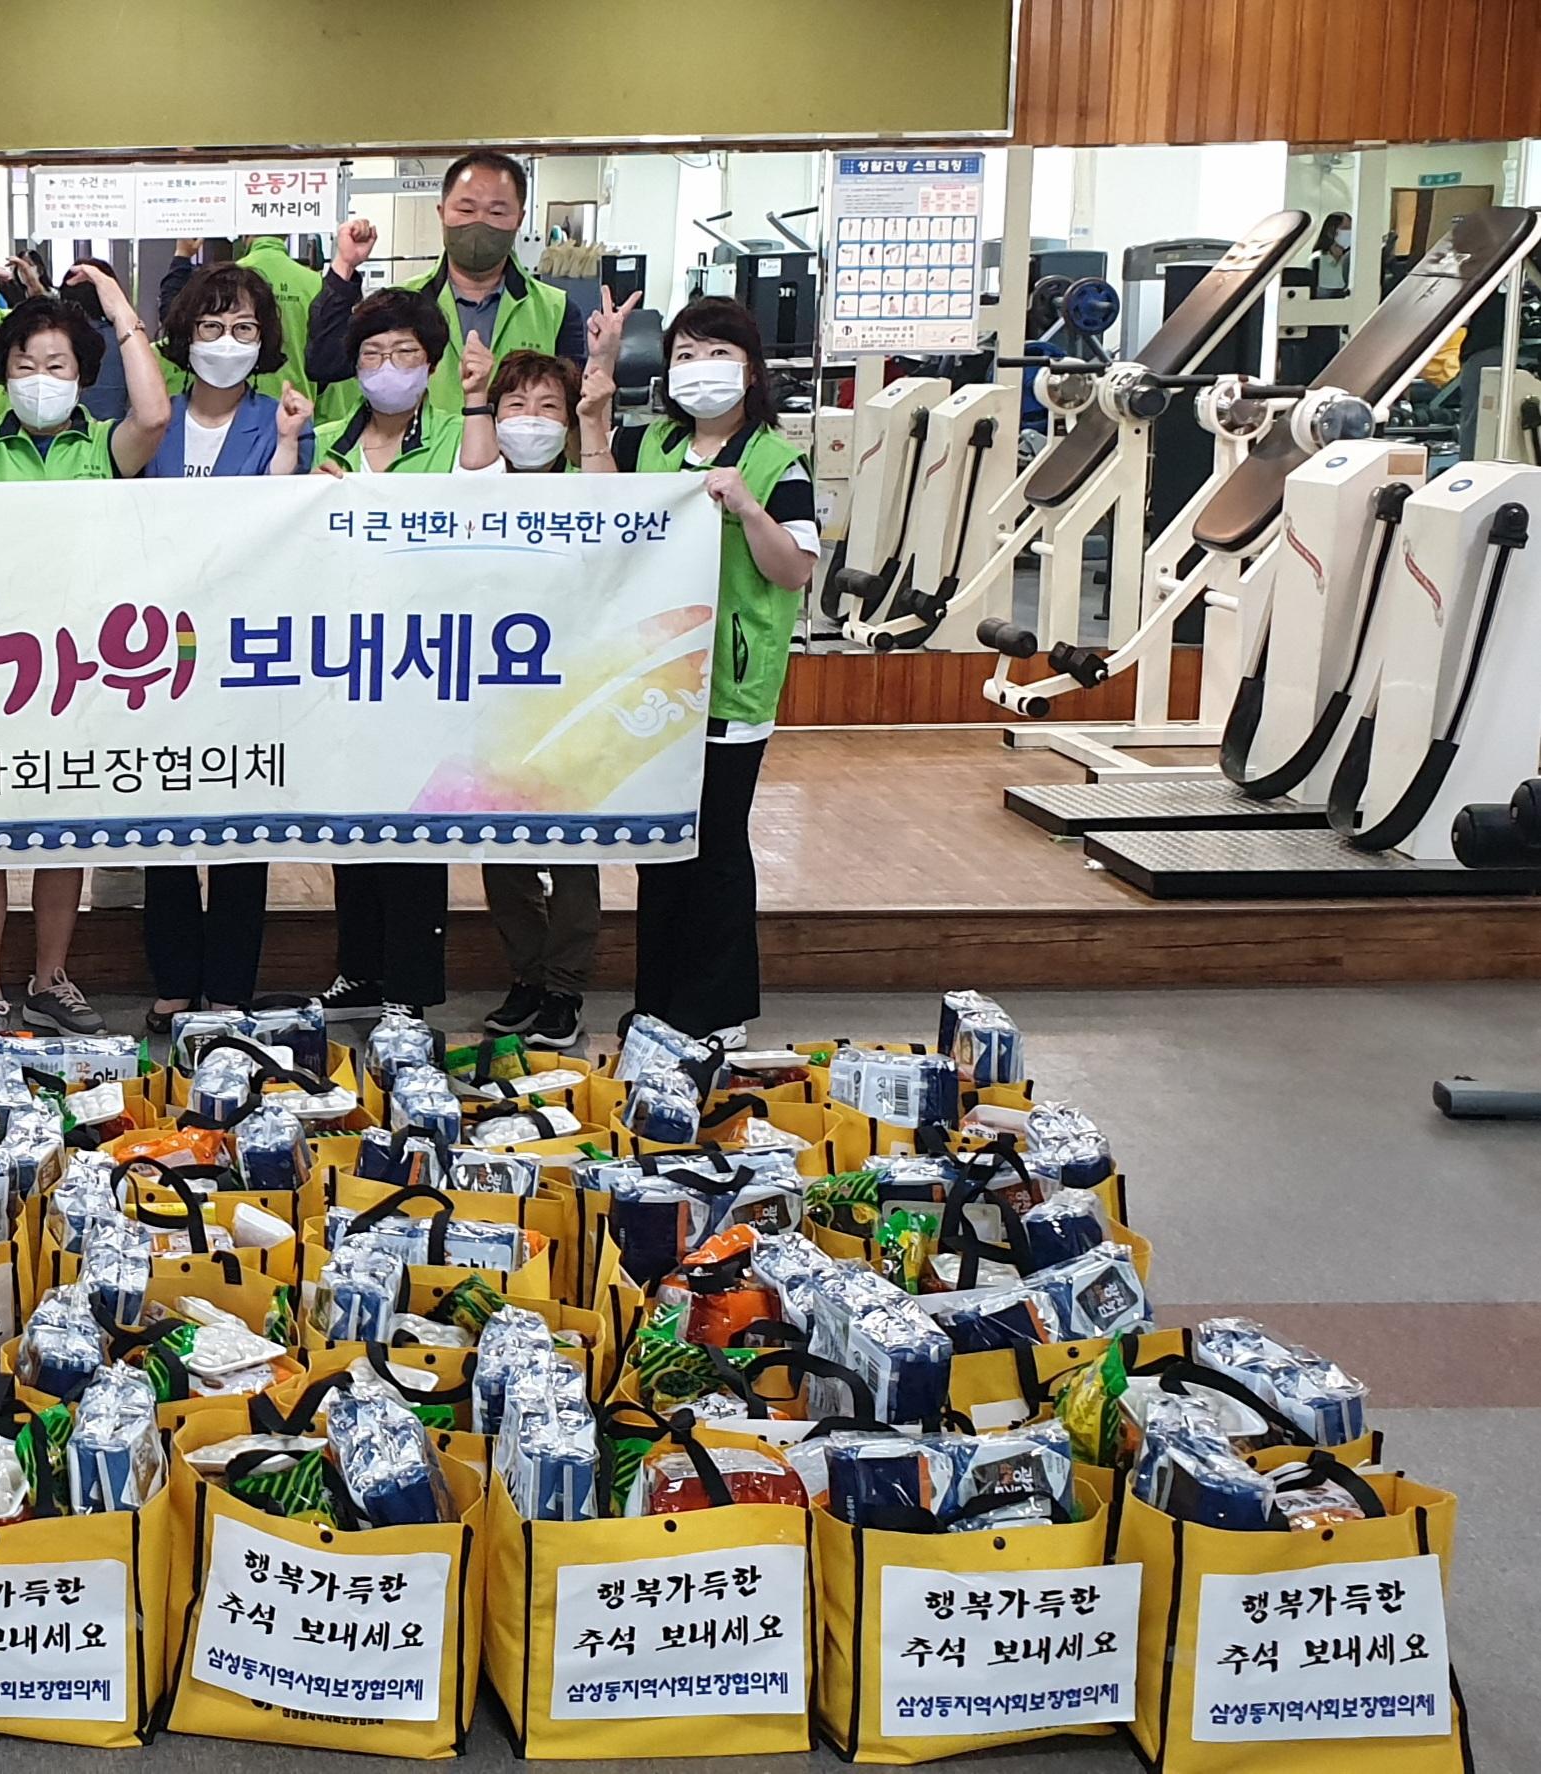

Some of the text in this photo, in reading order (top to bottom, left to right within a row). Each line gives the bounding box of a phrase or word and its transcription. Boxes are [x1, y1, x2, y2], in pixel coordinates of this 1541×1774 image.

[79, 177, 99, 189] 수건
[244, 171, 328, 195] 운동기구
[857, 160, 962, 173] 생활건강 스트레칭
[251, 201, 320, 218] 제자리에
[330, 511, 670, 544] 더 큰 변화 더 행복한 양산
[221, 613, 561, 701] 보내세요
[245, 1550, 407, 1604] 행복가득한
[597, 1565, 762, 1609] 행복가득한
[925, 1586, 1100, 1620] 행복가득한
[1242, 1580, 1405, 1624] 행복가득한
[218, 1592, 423, 1651] 추석 보내세요
[573, 1615, 783, 1658] 추석 보내세요
[901, 1631, 1117, 1667] 추석 보내세요
[1217, 1633, 1429, 1675] 추석 보내세요
[207, 1647, 423, 1701] 삼성동지역사회보장협의체
[567, 1672, 788, 1702] 삼성동지역사회보장협의체
[897, 1684, 1118, 1717] 삼성동지역사회보장협의체
[1210, 1694, 1434, 1724] 삼성동지역사회보장협의체
